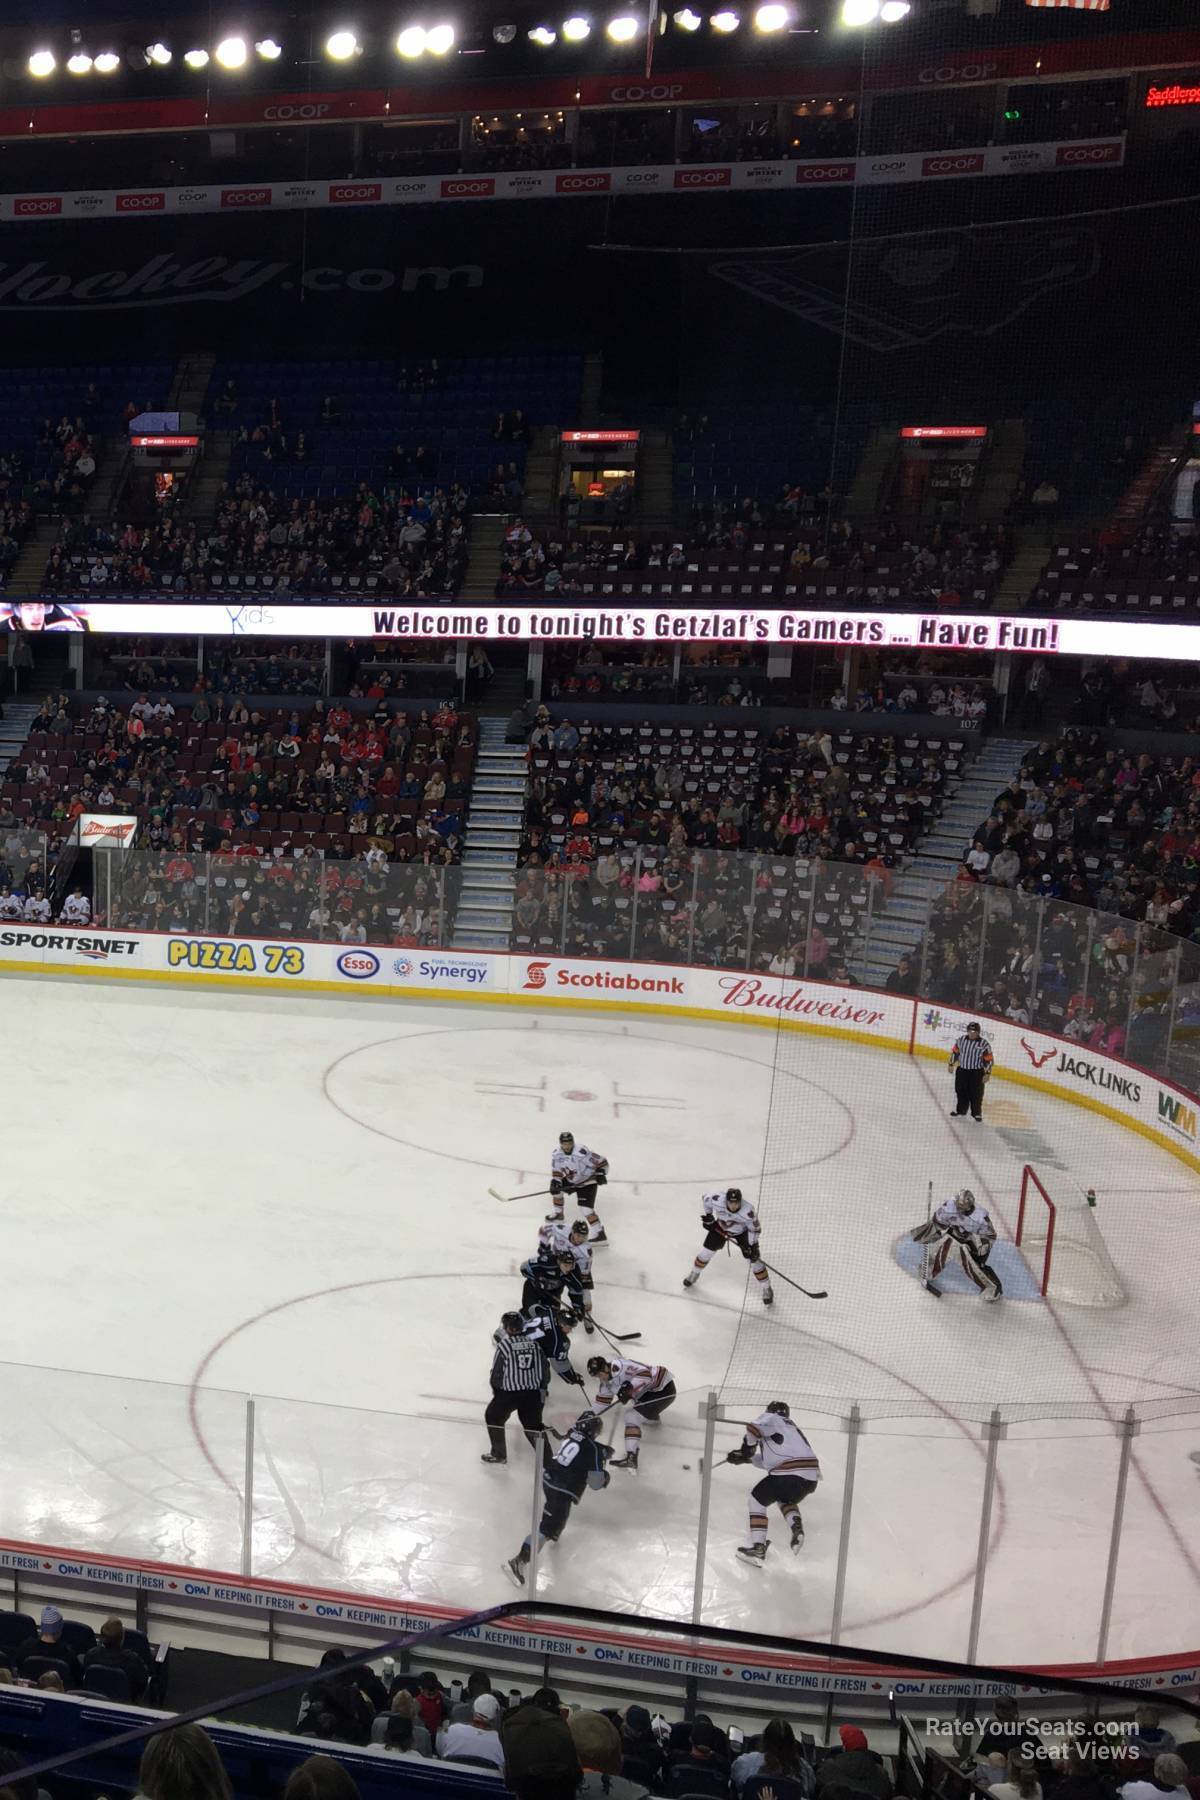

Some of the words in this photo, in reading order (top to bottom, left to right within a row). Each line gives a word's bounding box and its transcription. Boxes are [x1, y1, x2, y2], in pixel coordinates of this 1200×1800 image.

[373, 611, 489, 635] Welcome
[497, 613, 521, 636] to
[530, 613, 646, 640] tonight's
[655, 614, 770, 638] Getzlaf's
[779, 614, 883, 642] Gamers
[919, 619, 989, 645] Have
[1000, 621, 1058, 649] Fun!
[0, 932, 140, 955] SPORTSNET
[167, 938, 257, 972] PIZZA
[264, 945, 305, 975] 73
[420, 962, 488, 984] Synergy
[557, 969, 684, 995] Scotiabank
[718, 976, 885, 1026] Budweiser
[1057, 1053, 1098, 1086] JACK
[1099, 1067, 1142, 1103] LINK'S
[1158, 1090, 1197, 1138] WM
[518, 1354, 533, 1369] 87
[1, 1554, 9, 1565] IT
[12, 1555, 39, 1570] FRESH
[184, 1583, 211, 1597] OPA!
[214, 1588, 252, 1604] KEEPING
[255, 1594, 263, 1606] IT
[266, 1596, 295, 1612] FRESH
[594, 1646, 624, 1661] OPA!
[627, 1652, 670, 1670] KEEPING
[673, 1658, 682, 1671] IT
[685, 1659, 718, 1676] FRESH
[895, 1682, 925, 1695] OPA!
[929, 1683, 972, 1696] KEEPING
[973, 1683, 983, 1696] IT
[986, 1683, 1017, 1696] FRESH
